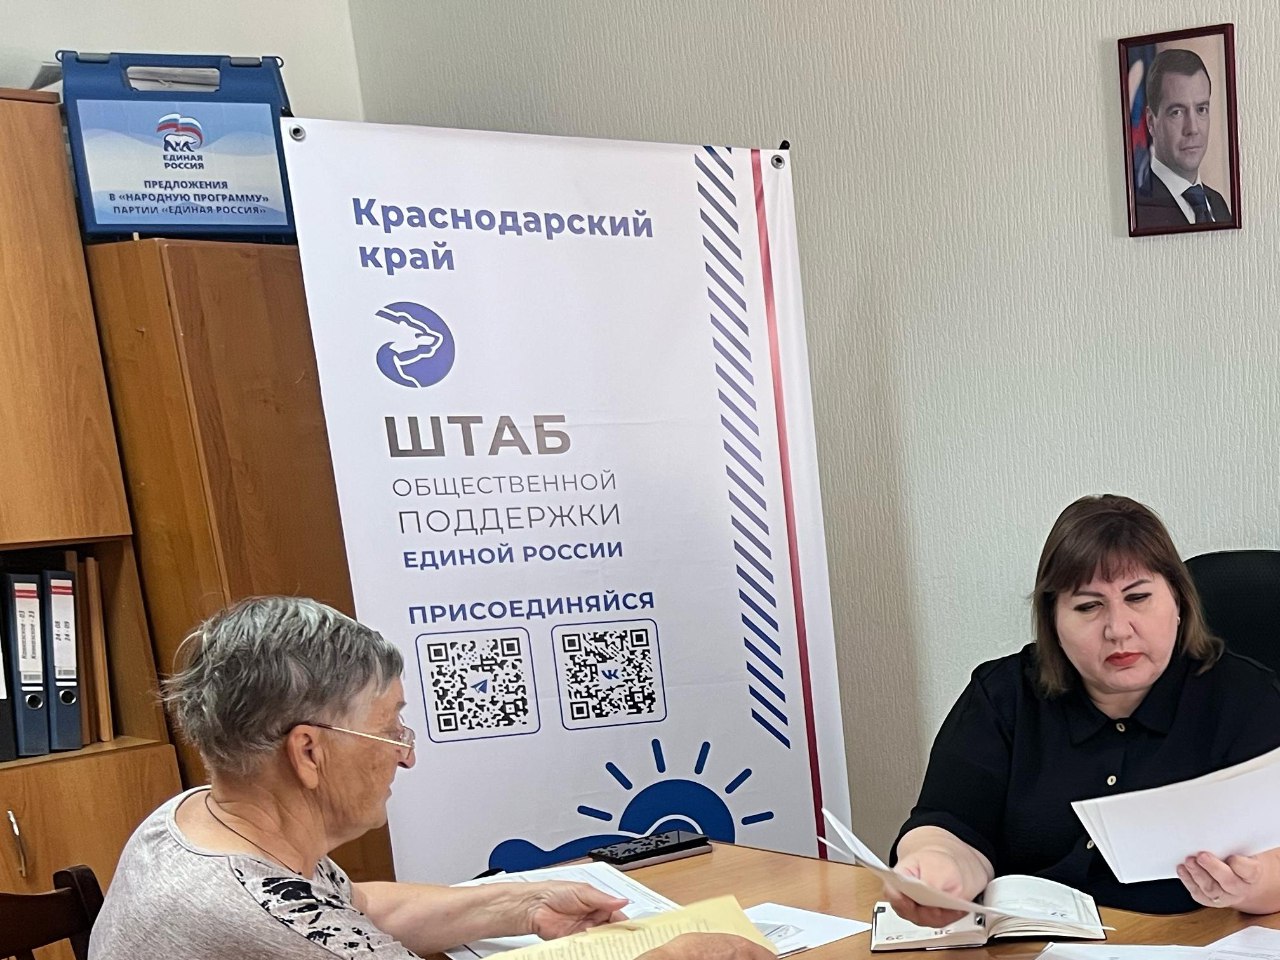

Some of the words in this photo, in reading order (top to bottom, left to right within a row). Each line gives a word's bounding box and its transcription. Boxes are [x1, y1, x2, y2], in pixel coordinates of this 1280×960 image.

[119, 193, 191, 203] «НАРОДНУЮ
[193, 194, 269, 202] ПРОГРАММУ»
[144, 180, 228, 190] ПРЕДЛОЖЕНИЯ
[113, 206, 158, 214] ПАРТИИ
[162, 206, 213, 215] «ЕДИНАЯ
[216, 206, 266, 214] РОССИЯ»
[352, 197, 653, 240] Краснодарский
[358, 241, 455, 275] край
[384, 414, 571, 457] ШТАБ
[392, 469, 617, 498] ОБЩЕСТВЕННОЙ
[398, 503, 621, 536] ПОДДЕРЖКИ
[403, 543, 515, 570] ЕДИНОЙ
[523, 541, 624, 563] РОССИИ
[408, 590, 655, 624] ПРИСОЕДИНЯЙСЯ
